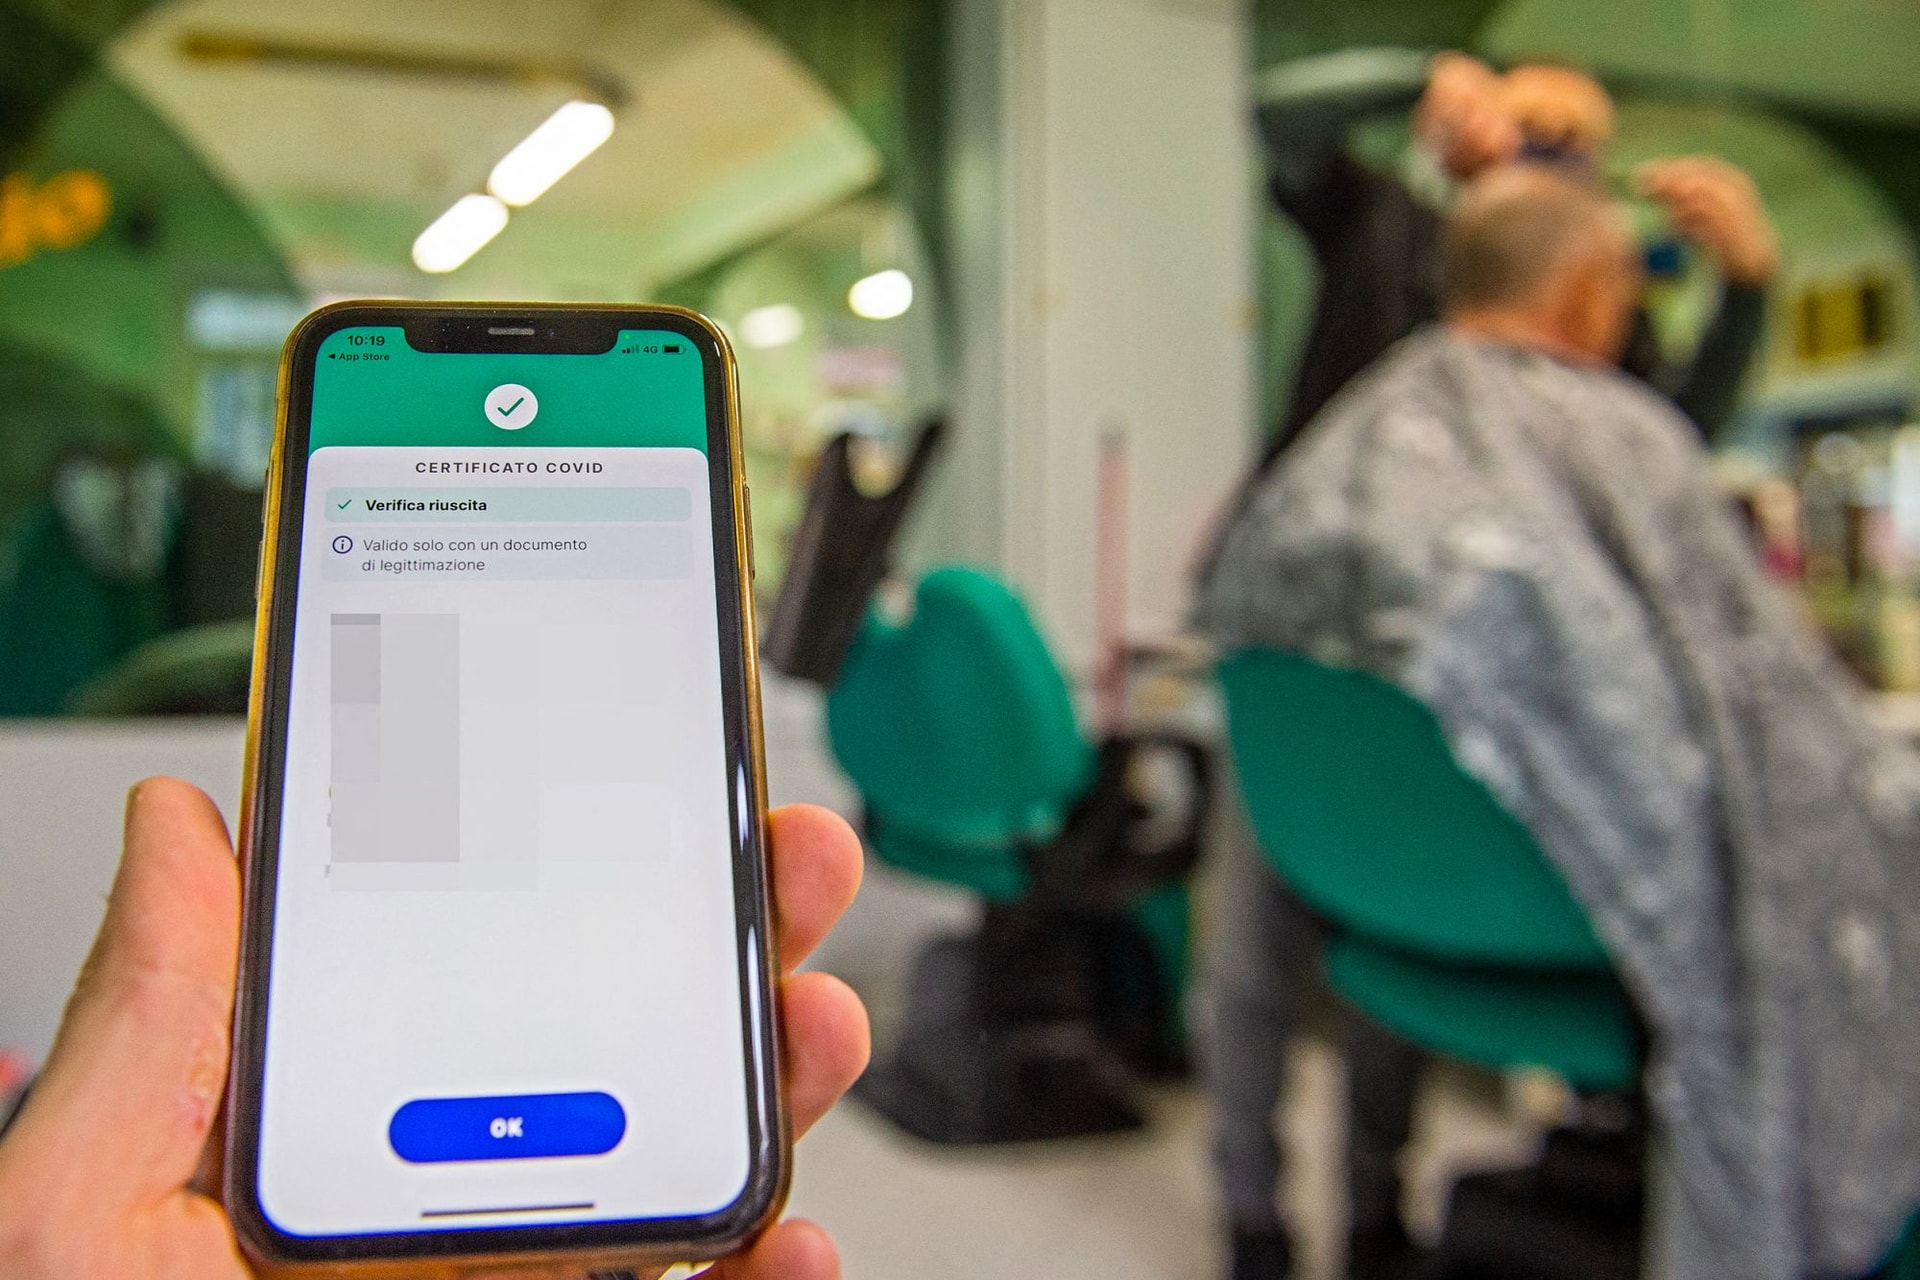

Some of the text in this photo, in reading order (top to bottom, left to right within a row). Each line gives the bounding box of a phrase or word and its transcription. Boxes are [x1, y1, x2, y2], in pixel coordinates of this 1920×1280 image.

[347, 335, 385, 347] 10:19
[643, 345, 658, 354] 4G
[338, 352, 390, 362] App Store
[415, 461, 604, 474] CERTIFICATO COVID
[365, 498, 487, 512] Verifica riuscita
[363, 538, 588, 552] Valido solo con un documento
[361, 558, 485, 574] di legittimazione
[489, 1116, 523, 1138] OK
